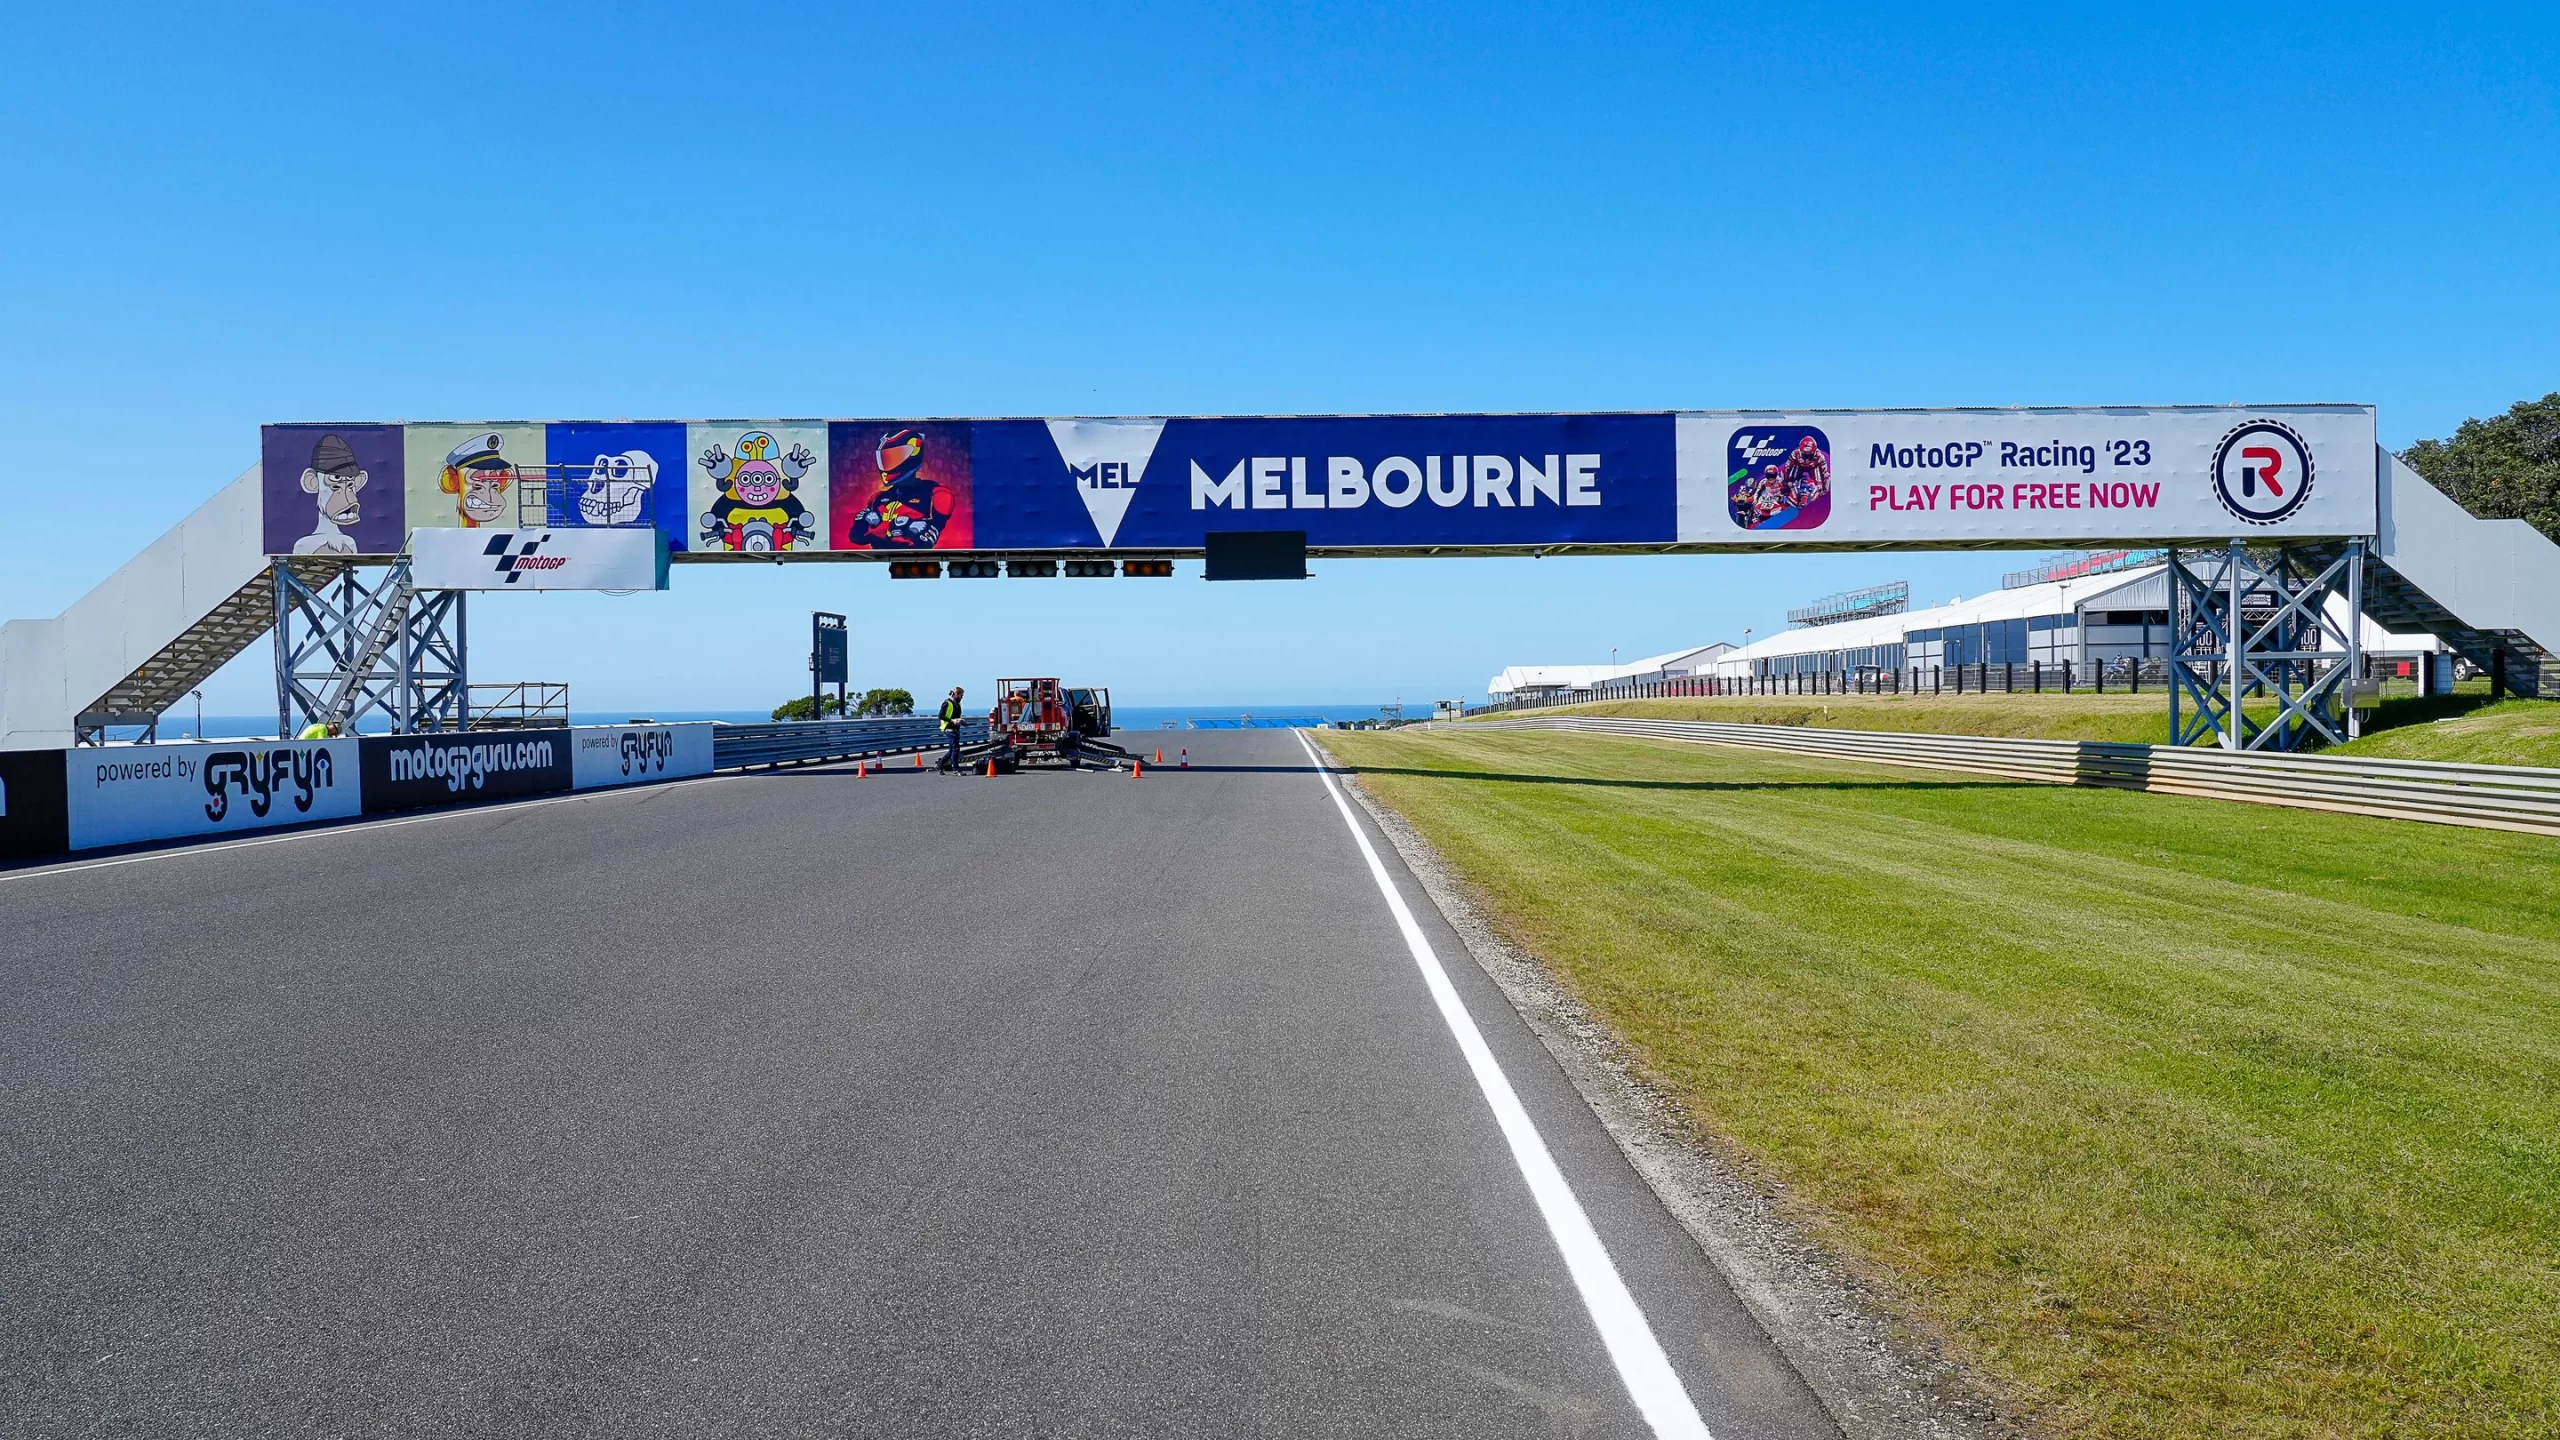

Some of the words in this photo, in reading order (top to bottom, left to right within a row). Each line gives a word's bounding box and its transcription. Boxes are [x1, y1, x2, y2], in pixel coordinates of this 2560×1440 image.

[2000, 439, 2096, 474] Racing
[1069, 462, 1140, 490] MEL
[1190, 453, 1602, 511] MELBOURNE
[1869, 484, 1942, 511] PLAY
[1949, 484, 2005, 510] FOR
[2012, 483, 2081, 509] FREE
[2089, 482, 2161, 509] NOW
[581, 734, 610, 753] powered
[611, 733, 619, 751] by
[96, 755, 172, 789] powered
[178, 754, 197, 783] by
[389, 739, 554, 793] motogpguru.com
